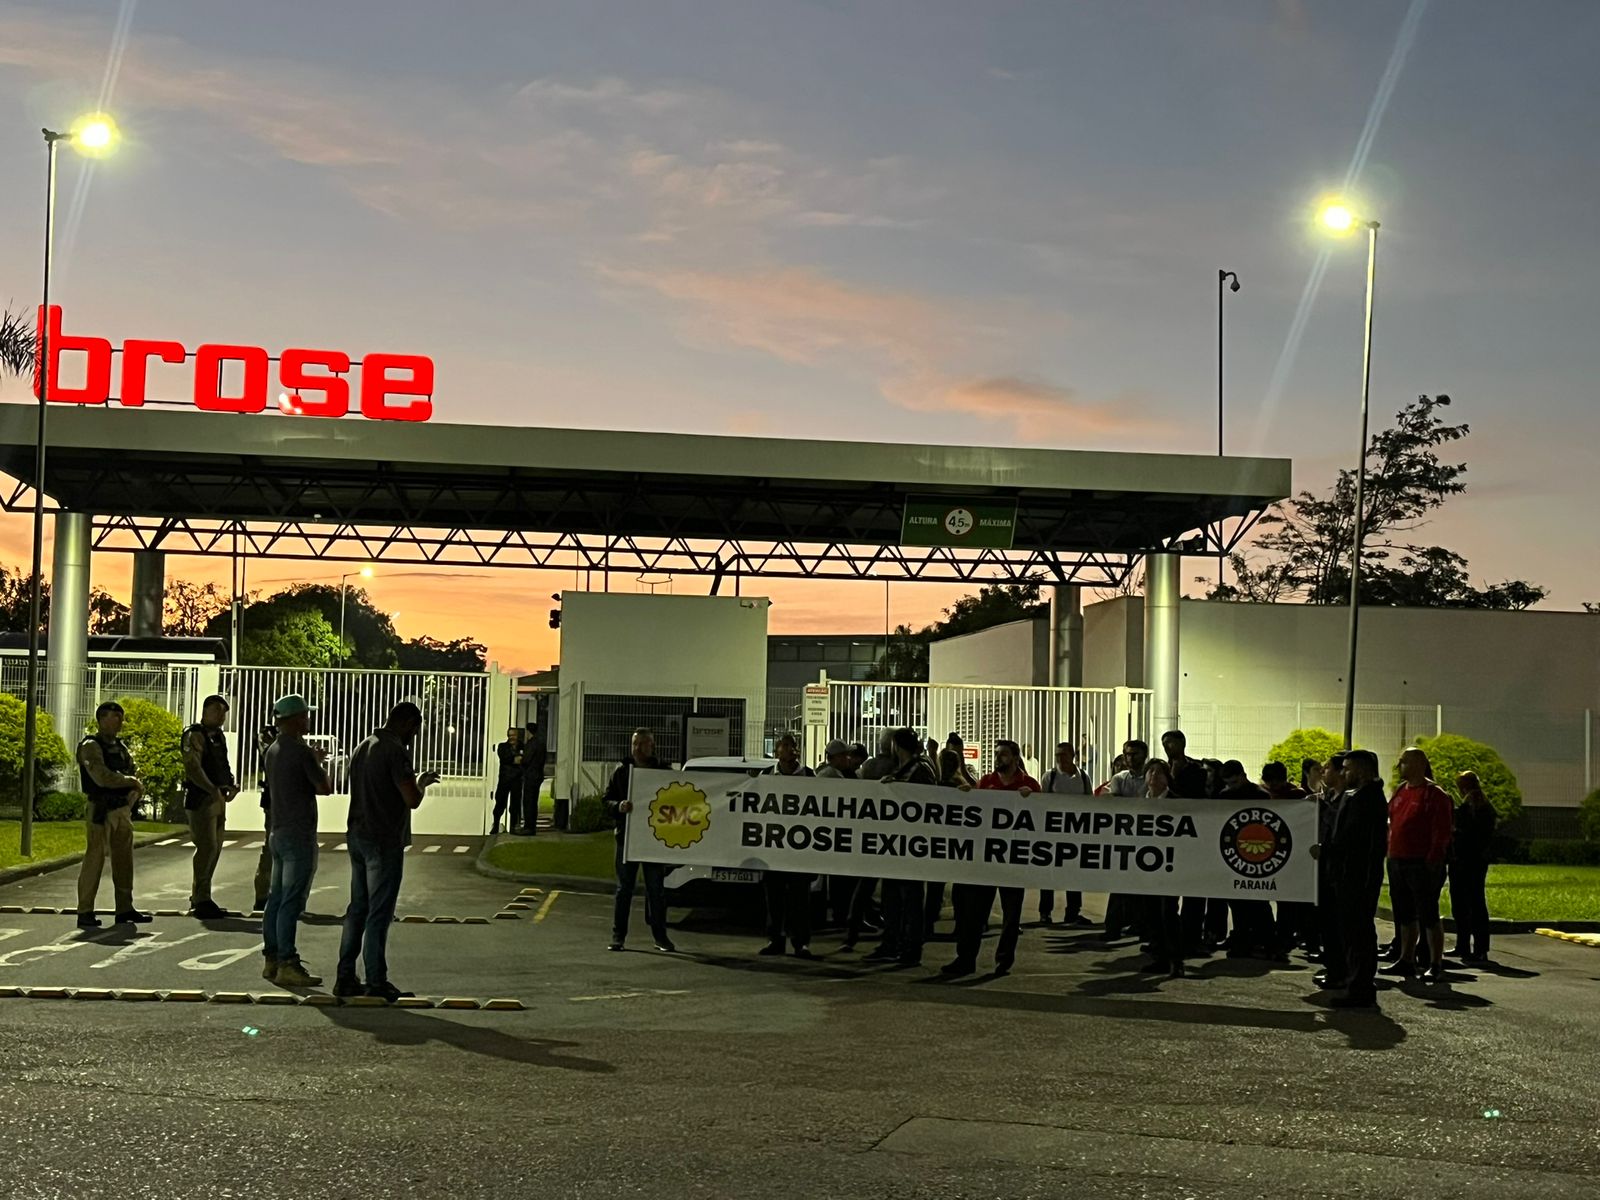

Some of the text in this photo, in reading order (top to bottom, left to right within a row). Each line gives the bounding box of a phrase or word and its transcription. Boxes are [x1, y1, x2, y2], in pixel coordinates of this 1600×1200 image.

[34, 304, 433, 421] brose
[909, 516, 938, 525] ALTURA
[979, 517, 1012, 527] MÁXIMA
[692, 725, 724, 735] brose
[657, 804, 702, 826] SMC
[726, 791, 1198, 838] TRABALHADORES DA EMPRESA
[1229, 810, 1281, 832] FORÇA
[741, 821, 1174, 872] BROSE EXIGEM RESPEITO!
[1224, 847, 1287, 875] SINDICAL
[1233, 878, 1277, 891] PARANÁ
